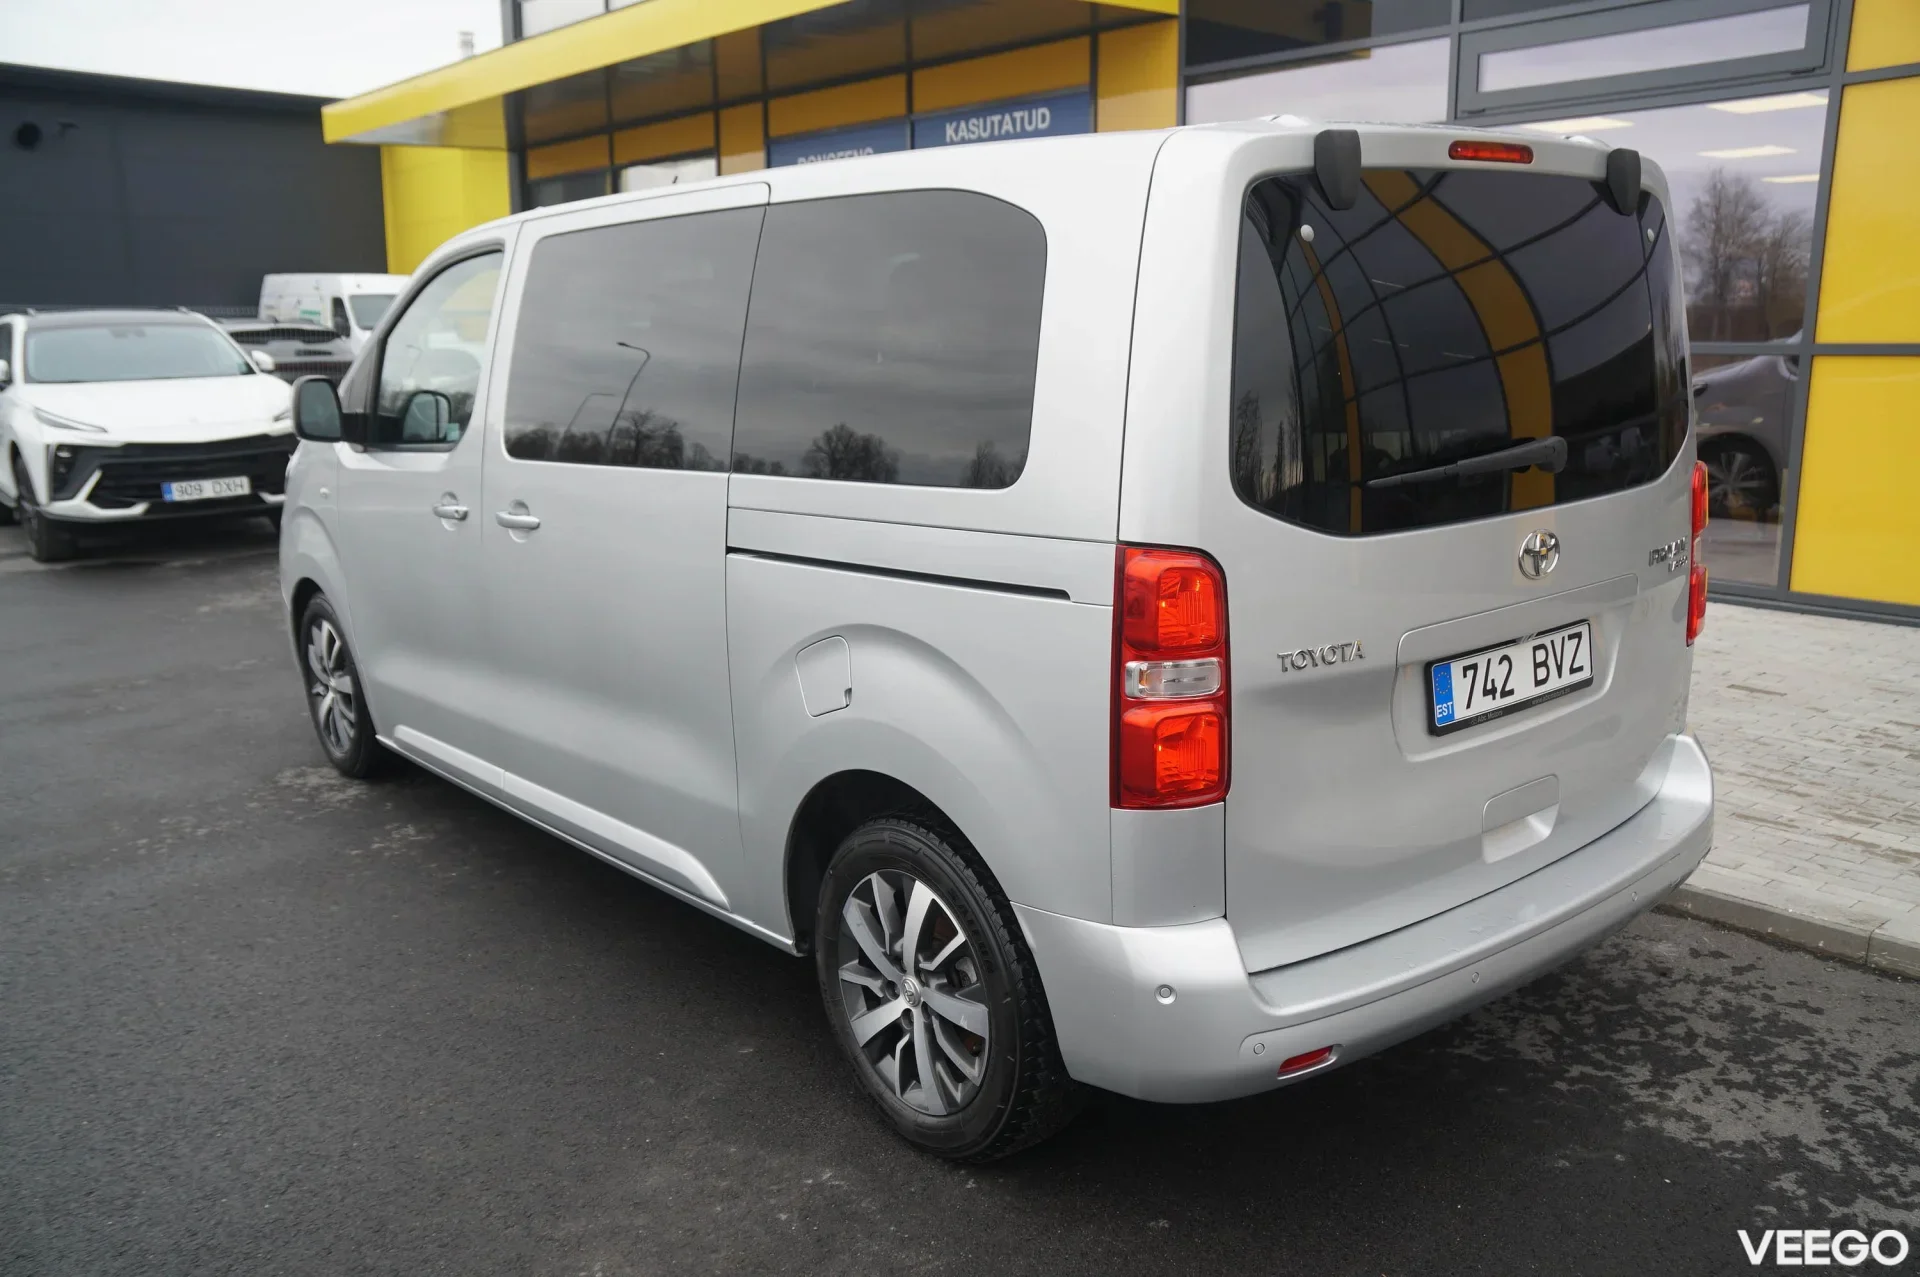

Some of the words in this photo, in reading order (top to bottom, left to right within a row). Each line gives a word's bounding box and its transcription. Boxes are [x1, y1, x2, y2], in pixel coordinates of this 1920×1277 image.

[945, 107, 1051, 143] KASUTATUD
[1277, 639, 1365, 673] TOYOTA
[1462, 654, 1515, 710] 742
[1532, 631, 1584, 688] BVZ
[1436, 701, 1453, 718] EST
